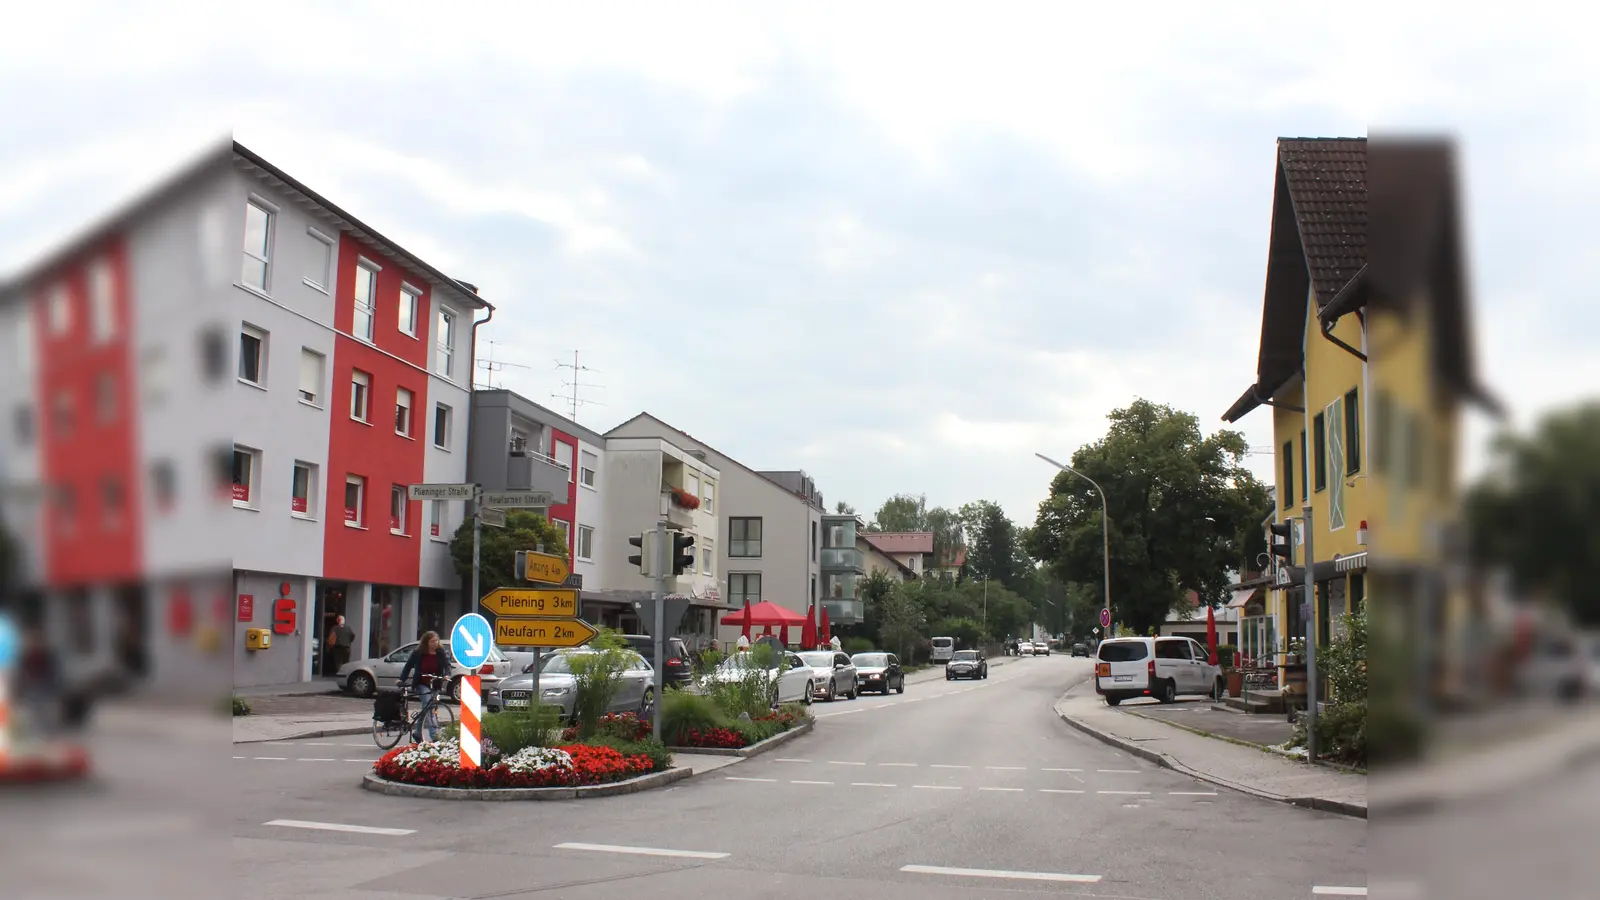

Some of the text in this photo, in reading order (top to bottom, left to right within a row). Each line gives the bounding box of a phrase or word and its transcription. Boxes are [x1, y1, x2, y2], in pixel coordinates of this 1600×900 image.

[413, 486, 469, 498] Plieninger Straße
[529, 558, 549, 576] Anzing
[500, 595, 545, 611] Pliening
[499, 624, 546, 638] Neufarn
